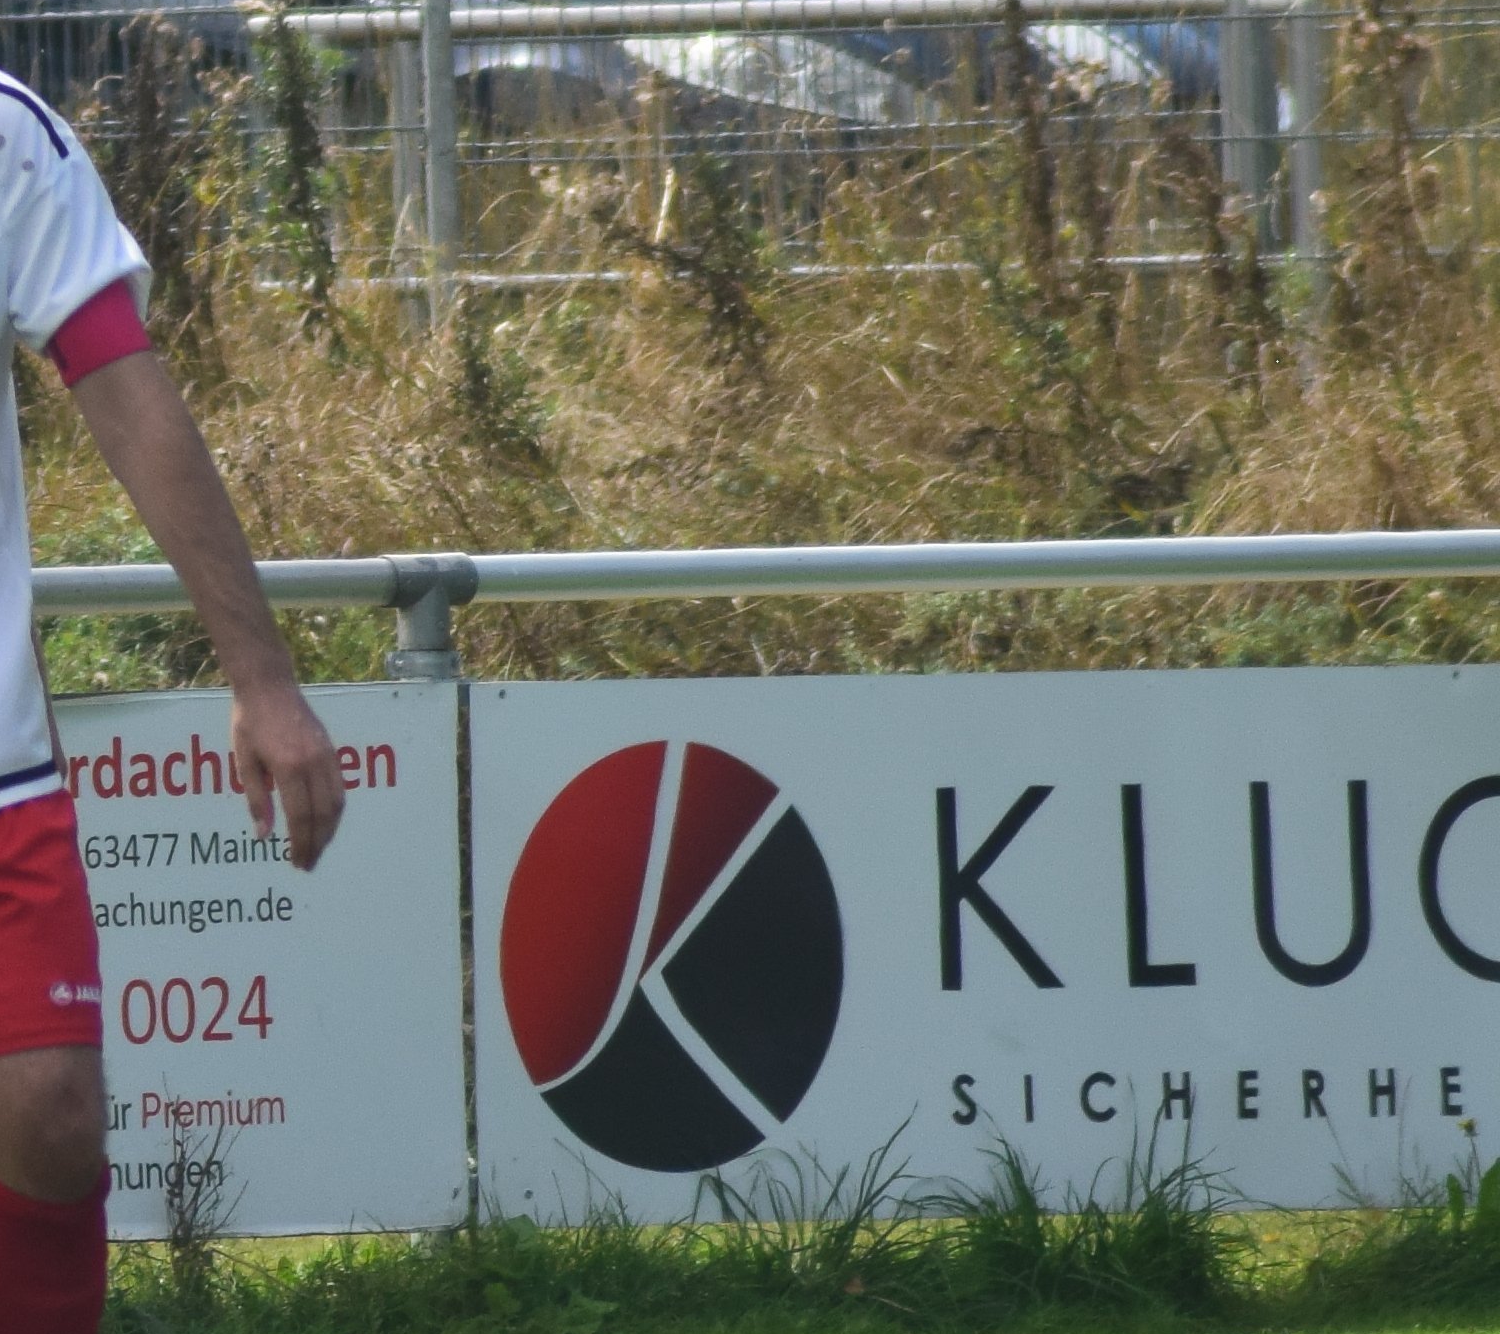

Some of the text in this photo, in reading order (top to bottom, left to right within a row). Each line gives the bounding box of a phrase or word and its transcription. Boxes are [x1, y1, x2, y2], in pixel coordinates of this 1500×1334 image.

[84, 833, 179, 869] 63477
[94, 887, 294, 934] achungen.de
[120, 974, 275, 1046] 0024
[141, 1088, 286, 1130] Premium
[951, 1065, 1464, 1127] SICHERHE
